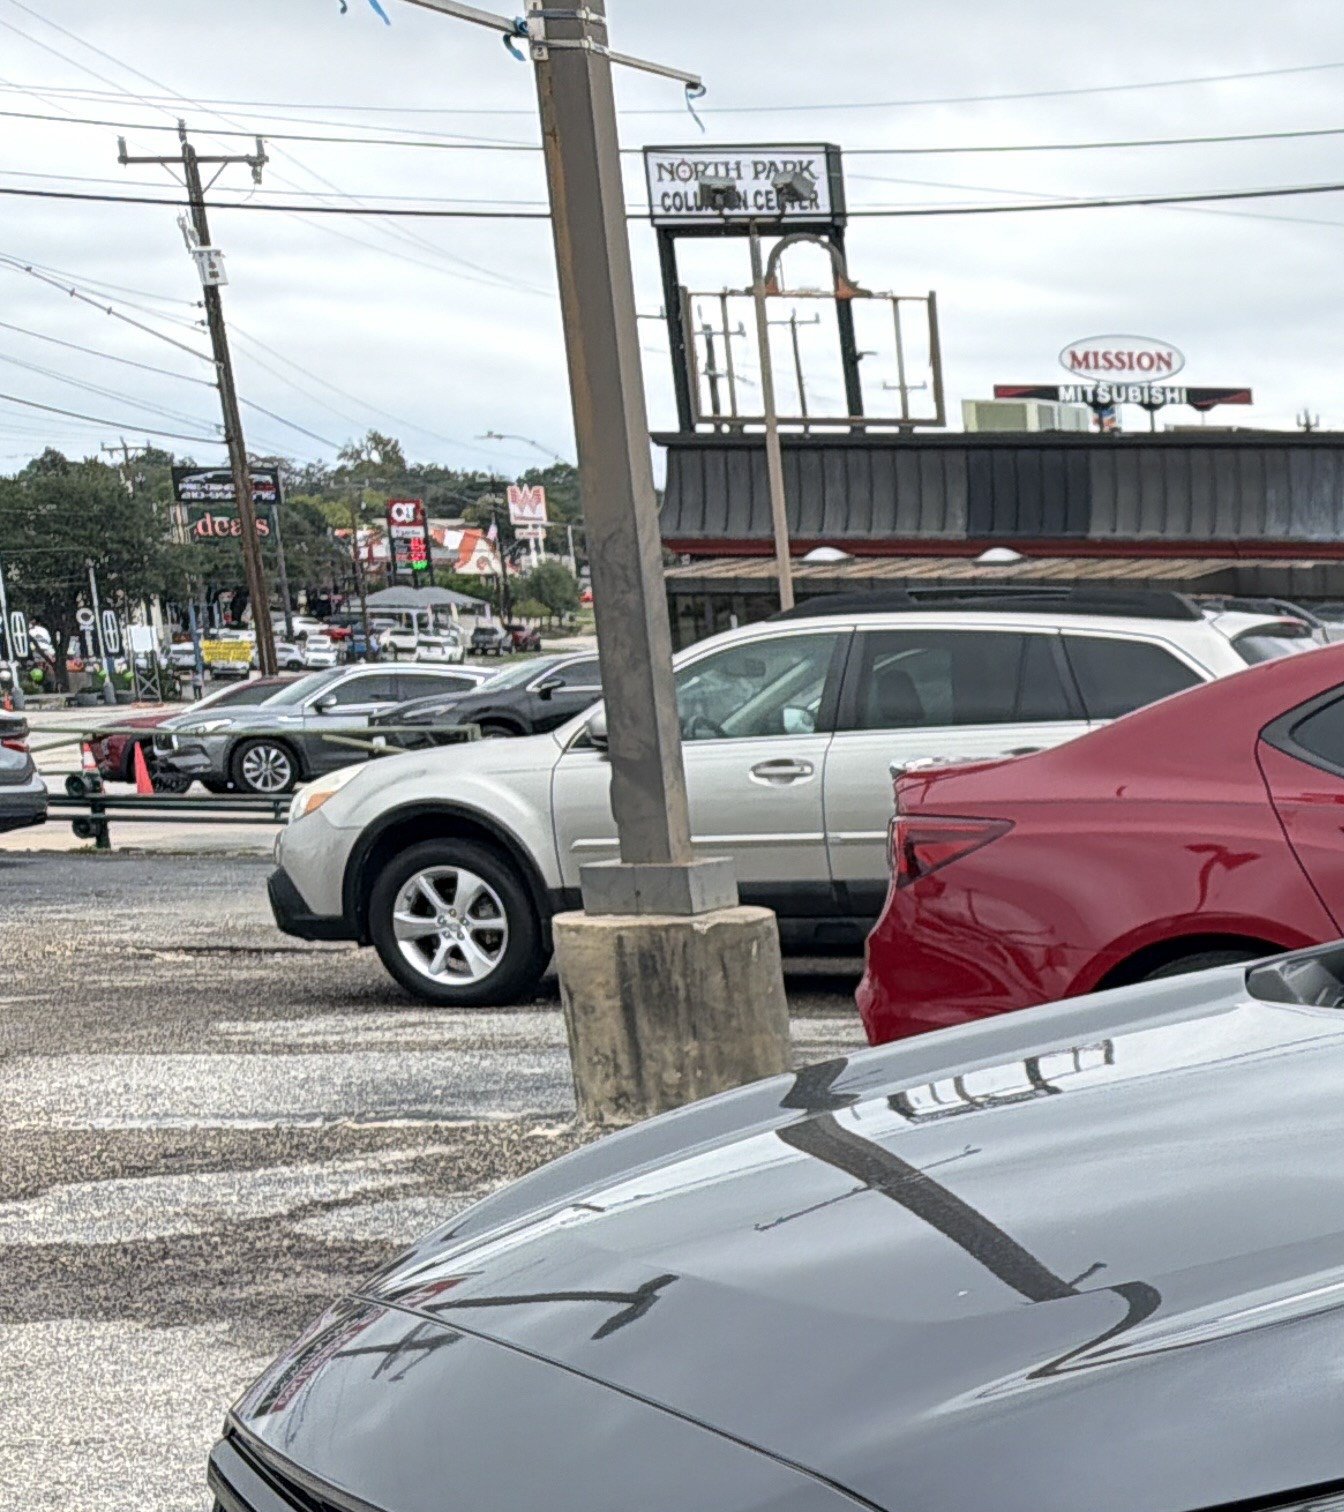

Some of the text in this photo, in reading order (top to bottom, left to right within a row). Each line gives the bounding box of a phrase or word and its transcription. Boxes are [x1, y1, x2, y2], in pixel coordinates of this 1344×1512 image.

[657, 159, 819, 182] NORTH PARK
[661, 190, 749, 212] COLLN
[1069, 350, 1173, 372] MISSION
[1058, 384, 1187, 404] MITSUBISHI
[197, 512, 270, 537] deas
